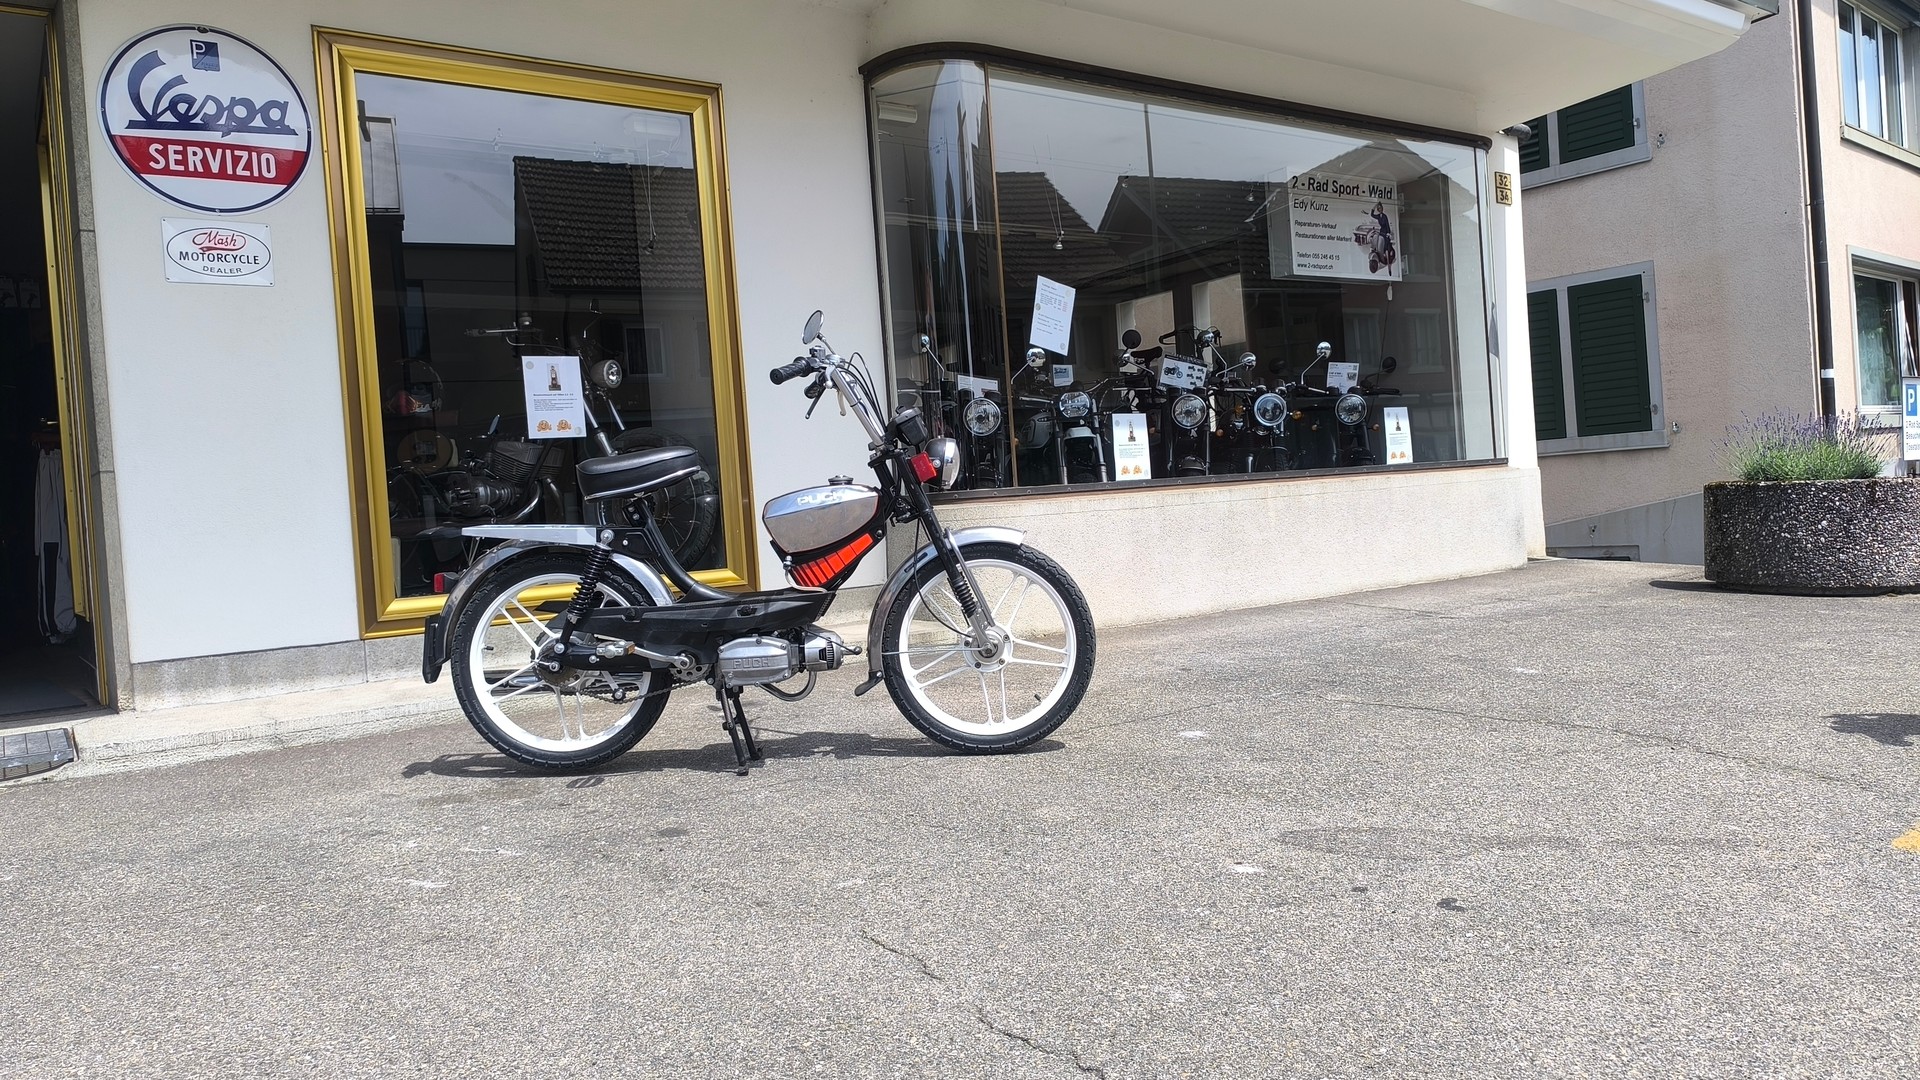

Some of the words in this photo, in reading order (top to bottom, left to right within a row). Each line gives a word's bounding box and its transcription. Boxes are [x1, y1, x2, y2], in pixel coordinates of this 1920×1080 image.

[125, 50, 299, 138] Vespa
[148, 143, 277, 179] SERVIZIO
[1292, 175, 1299, 189] 2
[1307, 177, 1329, 192] Rad
[1331, 180, 1360, 197] Sport
[1368, 184, 1393, 200] Wald
[1498, 174, 1508, 187] 32
[1293, 199, 1309, 212] Edy
[1310, 201, 1329, 212] Kunz
[192, 230, 247, 252] Mash
[179, 250, 260, 265] MOTORCYCLE
[1296, 251, 1311, 259] Telefon
[202, 265, 243, 275] DEALER
[1907, 388, 1915, 412] P
[733, 658, 770, 669] PUCH
